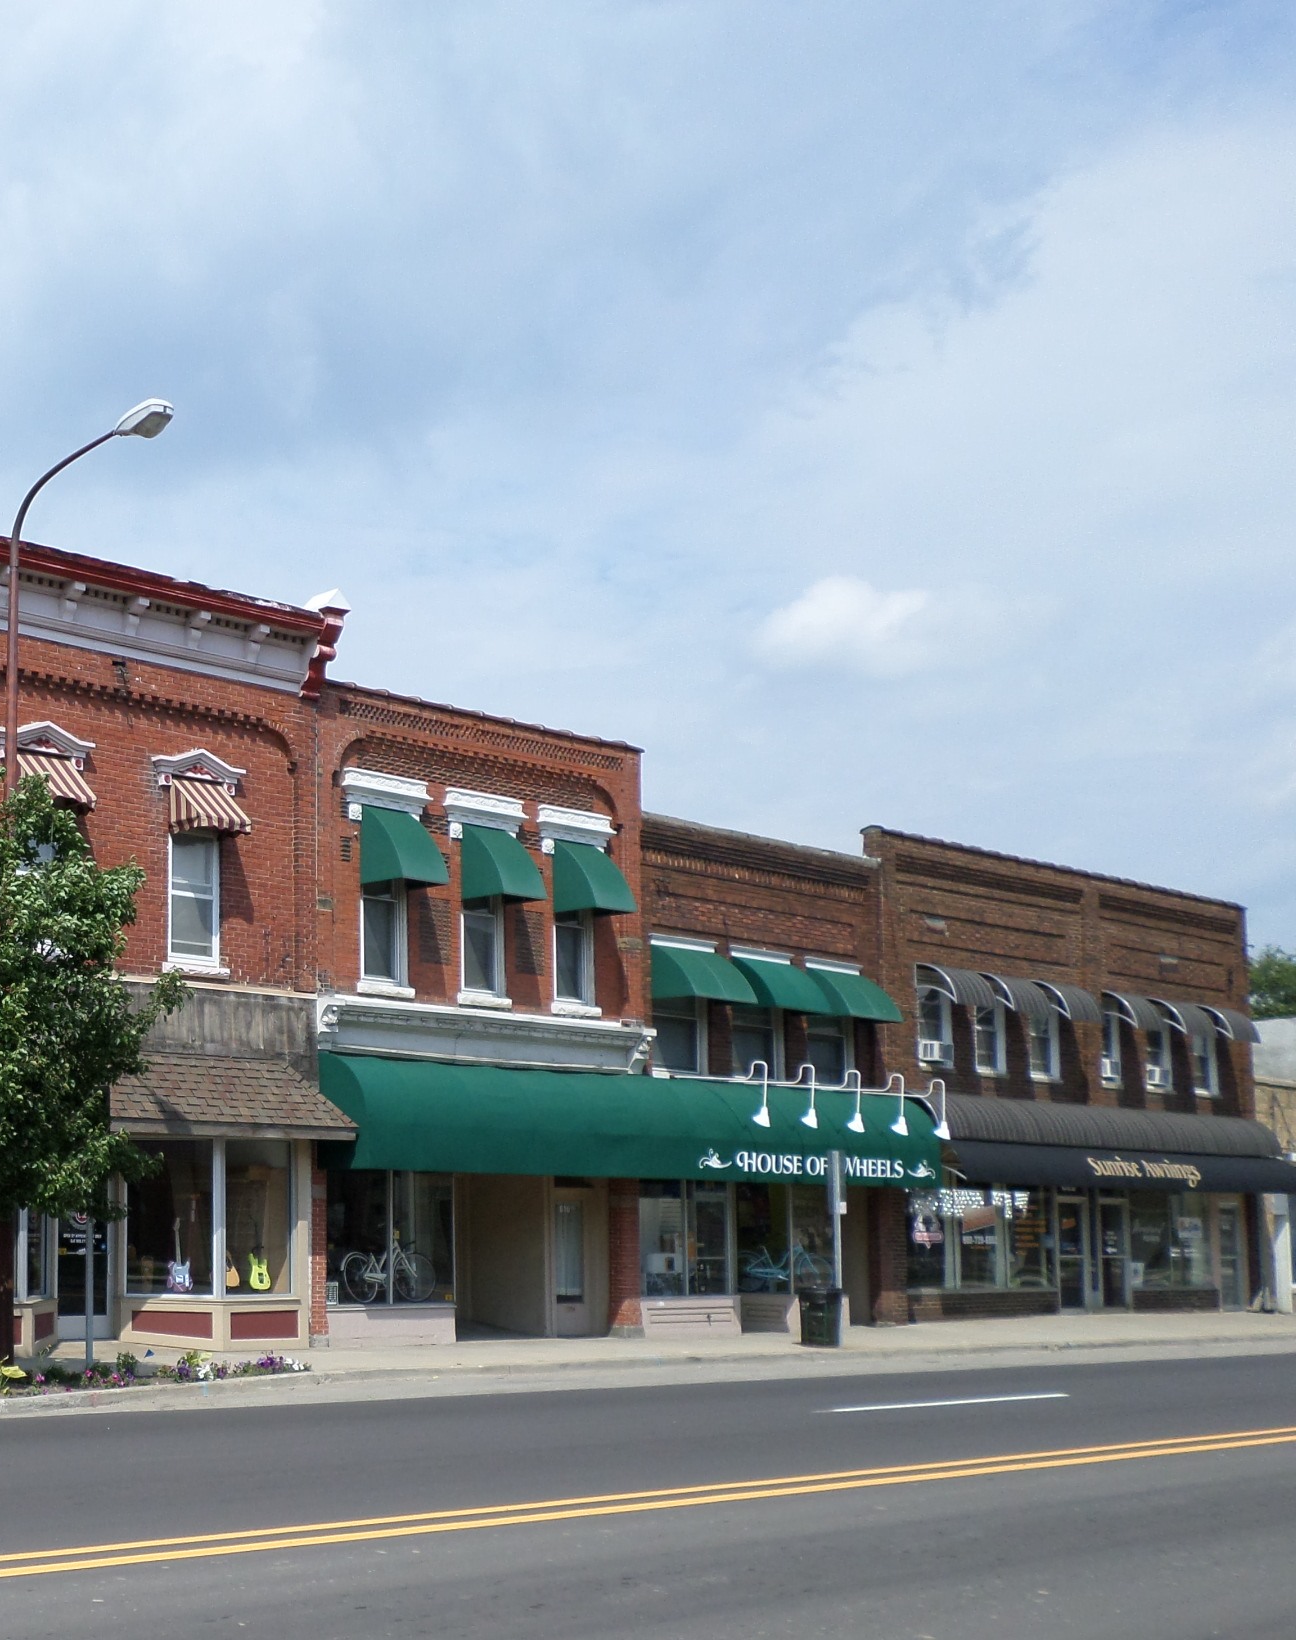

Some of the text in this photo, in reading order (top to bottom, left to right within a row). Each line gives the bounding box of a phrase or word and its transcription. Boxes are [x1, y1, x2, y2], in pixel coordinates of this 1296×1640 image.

[736, 1151, 905, 1179] HOUSE OF WHEELS
[1087, 1156, 1202, 1188] Sunrise Awnings
